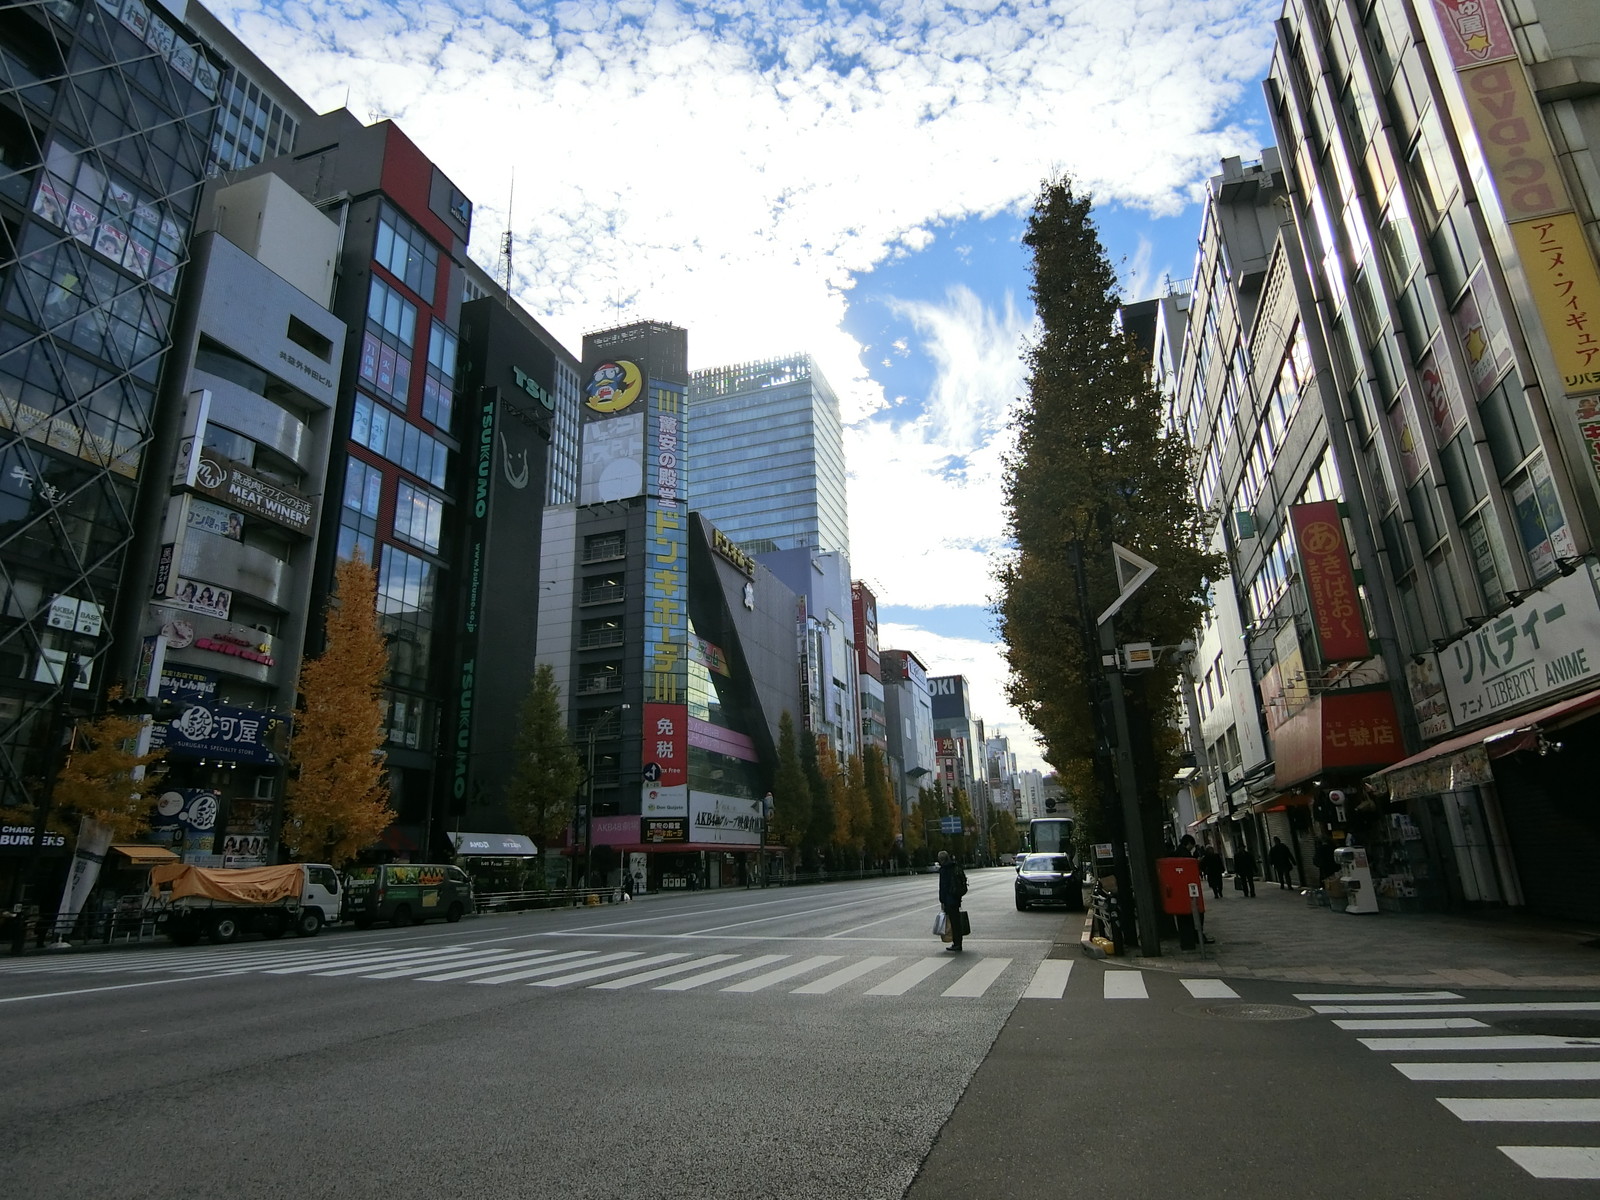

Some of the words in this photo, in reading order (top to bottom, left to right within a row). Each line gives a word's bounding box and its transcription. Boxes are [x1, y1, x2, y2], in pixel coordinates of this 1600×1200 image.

[1531, 222, 1600, 366] アニメ・フィギュア
[280, 351, 333, 388] 共益外神田ビル
[475, 401, 493, 519] TSUKUMO
[658, 414, 678, 508] 驚安の殿堂
[229, 484, 263, 506] MEAT
[266, 500, 311, 525] WINERY
[232, 470, 312, 514] 熟成肉とワインのお店
[257, 507, 276, 519] AGING
[469, 543, 481, 634] www.tsukumo.co.jp
[1307, 558, 1333, 639] akibaoo.co.jp
[52, 605, 75, 615] AKIBA
[80, 612, 100, 621] BASE
[1454, 603, 1566, 684] リバティー
[927, 677, 956, 696] OKI
[1460, 695, 1482, 719] アニメ
[1485, 666, 1539, 709] LIBERTY
[1544, 648, 1591, 688] ANIME
[178, 741, 208, 750] SURUGAYA
[210, 745, 237, 753] SPECIALTY
[453, 657, 474, 800] TSUKUMO
[656, 717, 674, 759] 免税
[1326, 724, 1395, 748] 七號店
[2, 826, 36, 834] CHARC
